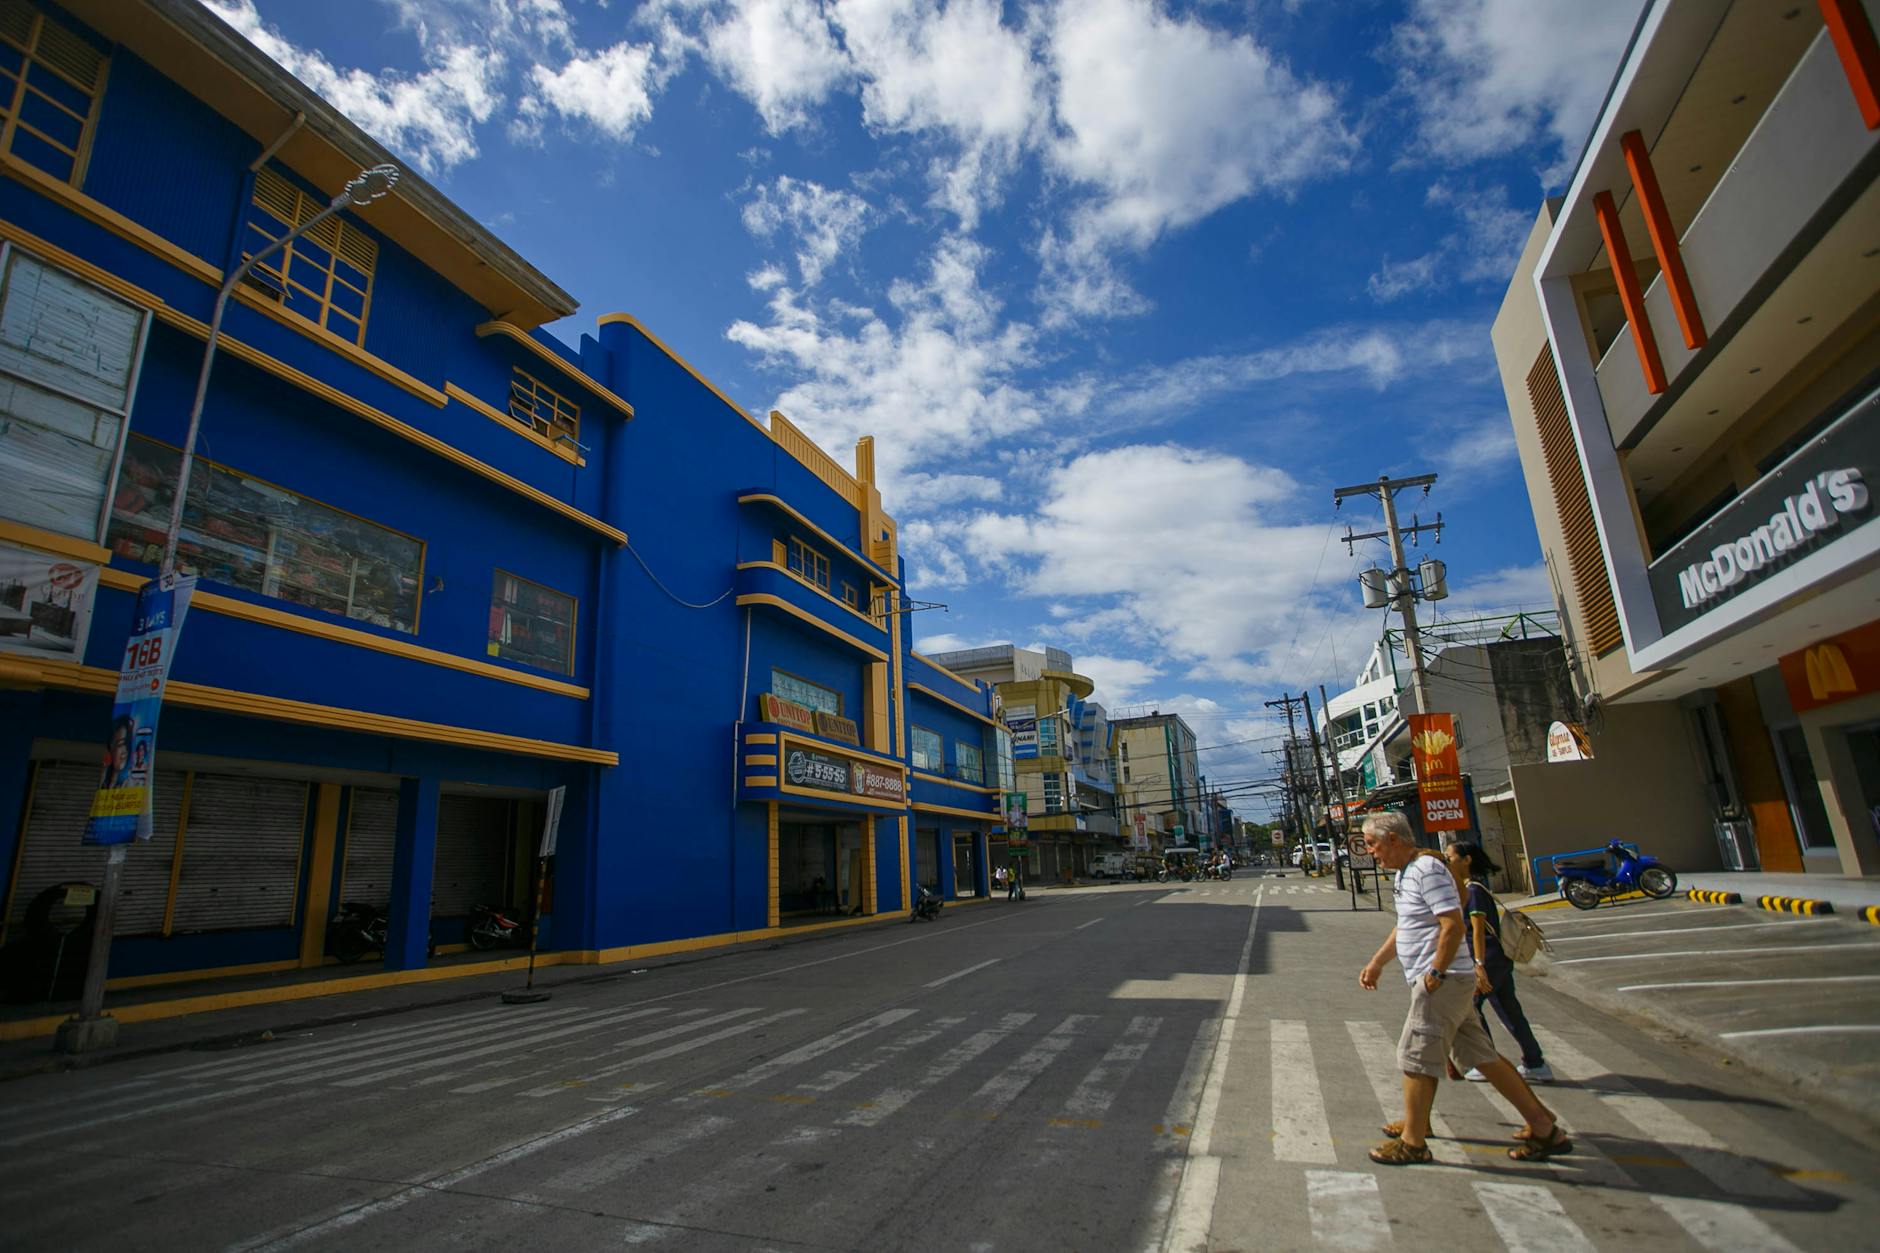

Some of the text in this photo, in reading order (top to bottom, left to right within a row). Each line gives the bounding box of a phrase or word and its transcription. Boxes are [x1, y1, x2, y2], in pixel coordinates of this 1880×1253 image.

[1678, 467, 1867, 609] McDonald's
[127, 637, 162, 671] 1GB
[779, 702, 811, 725] UNITOP
[1426, 799, 1460, 811] NOW
[1426, 809, 1464, 822] OPEN
